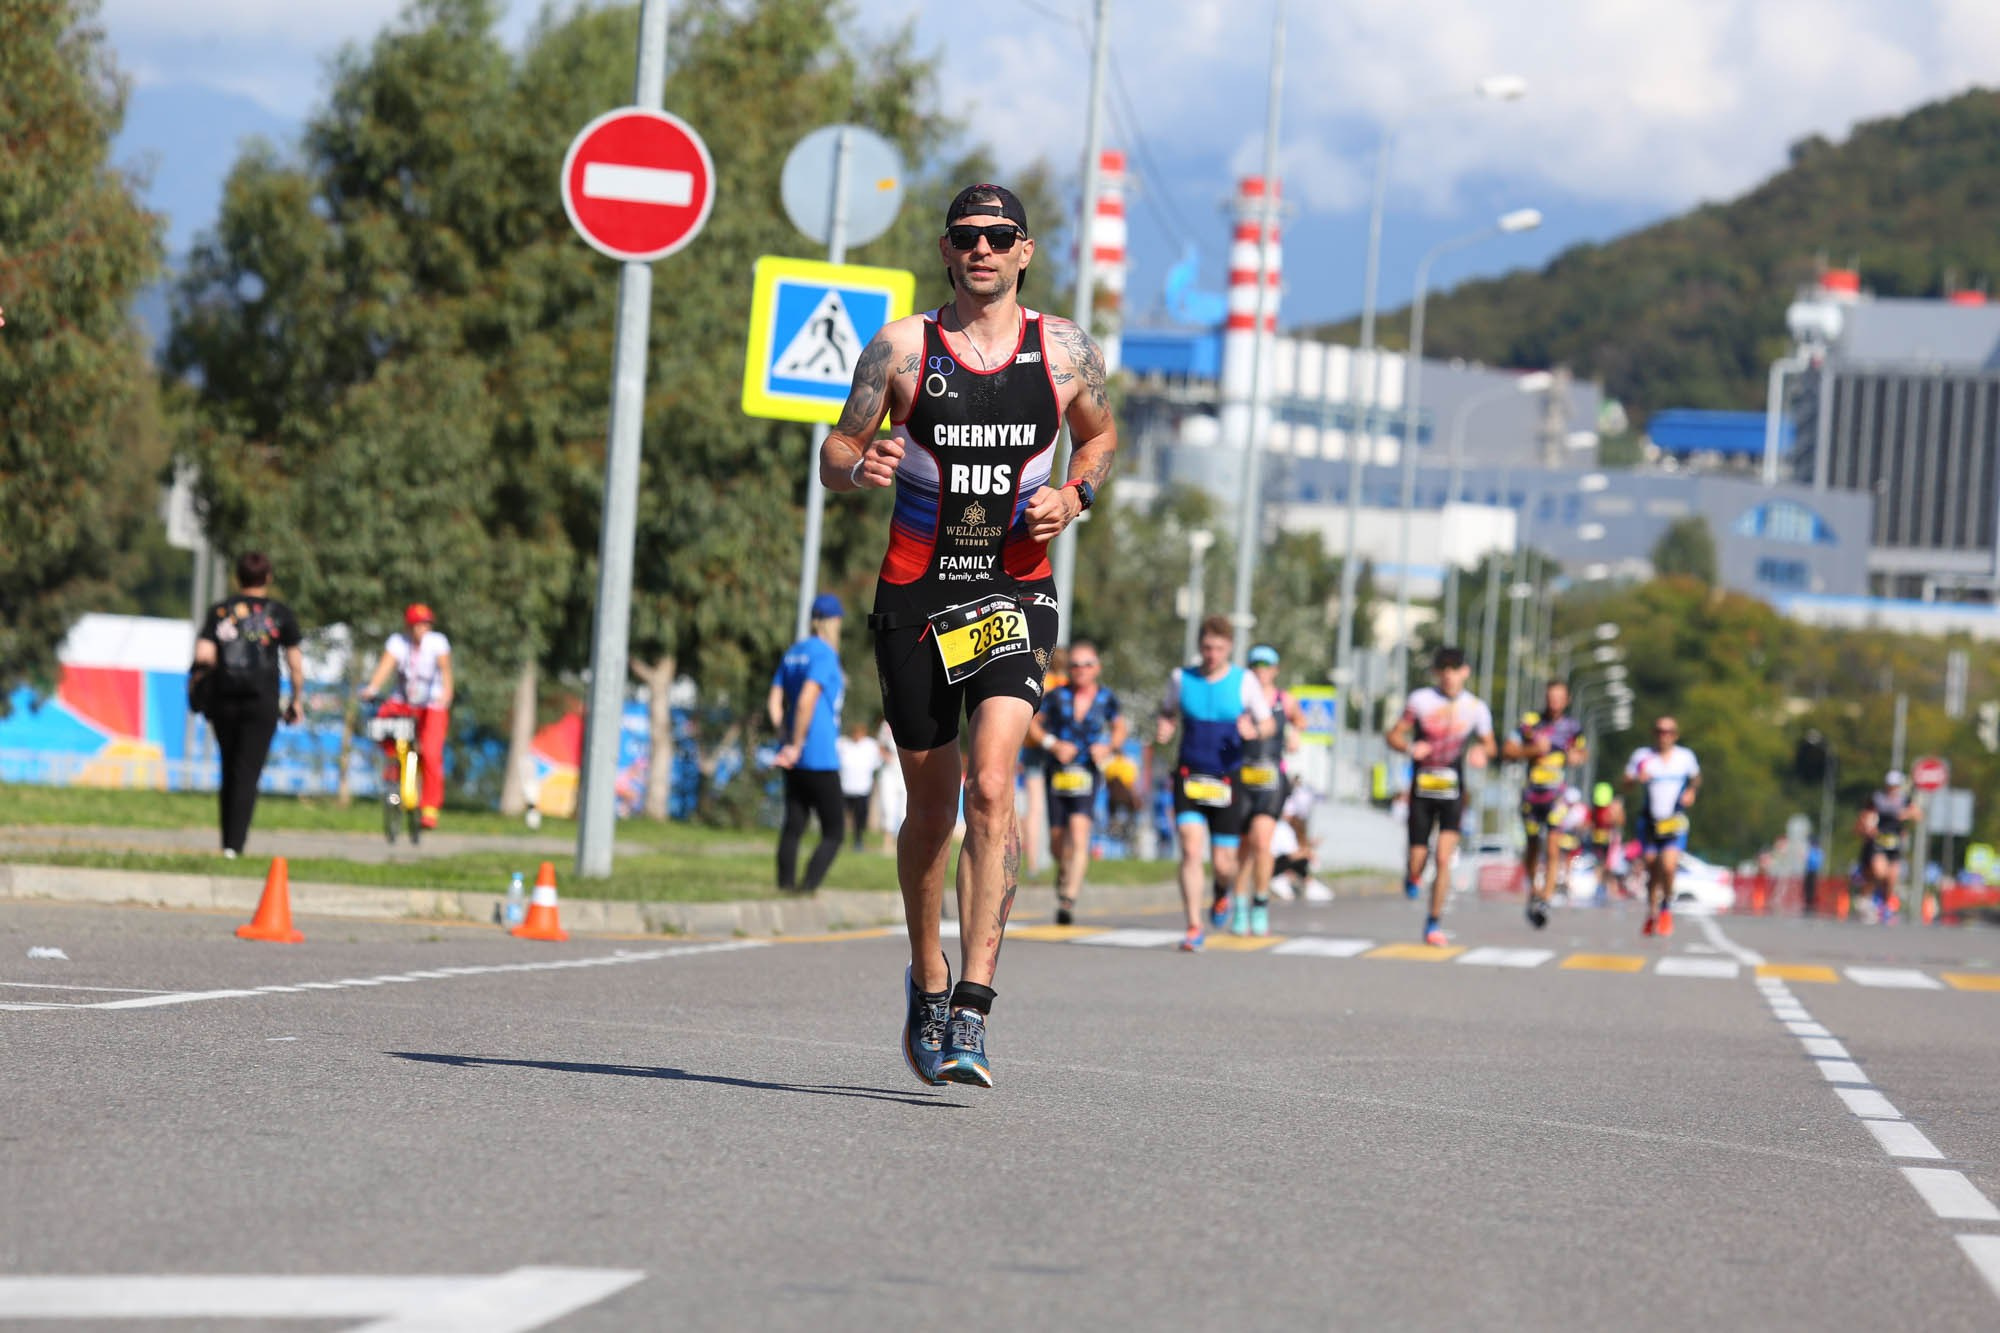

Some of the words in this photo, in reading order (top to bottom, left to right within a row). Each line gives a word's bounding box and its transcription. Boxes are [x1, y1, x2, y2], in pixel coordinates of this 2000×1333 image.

[934, 424, 1037, 447] CHERNYKH
[950, 464, 1012, 496] RUS
[946, 526, 1003, 537] WELLNESS
[940, 555, 996, 570] FAMILY
[948, 571, 994, 582] family_ekb_
[969, 614, 1020, 656] 2332
[991, 642, 1022, 657] SERGEY
